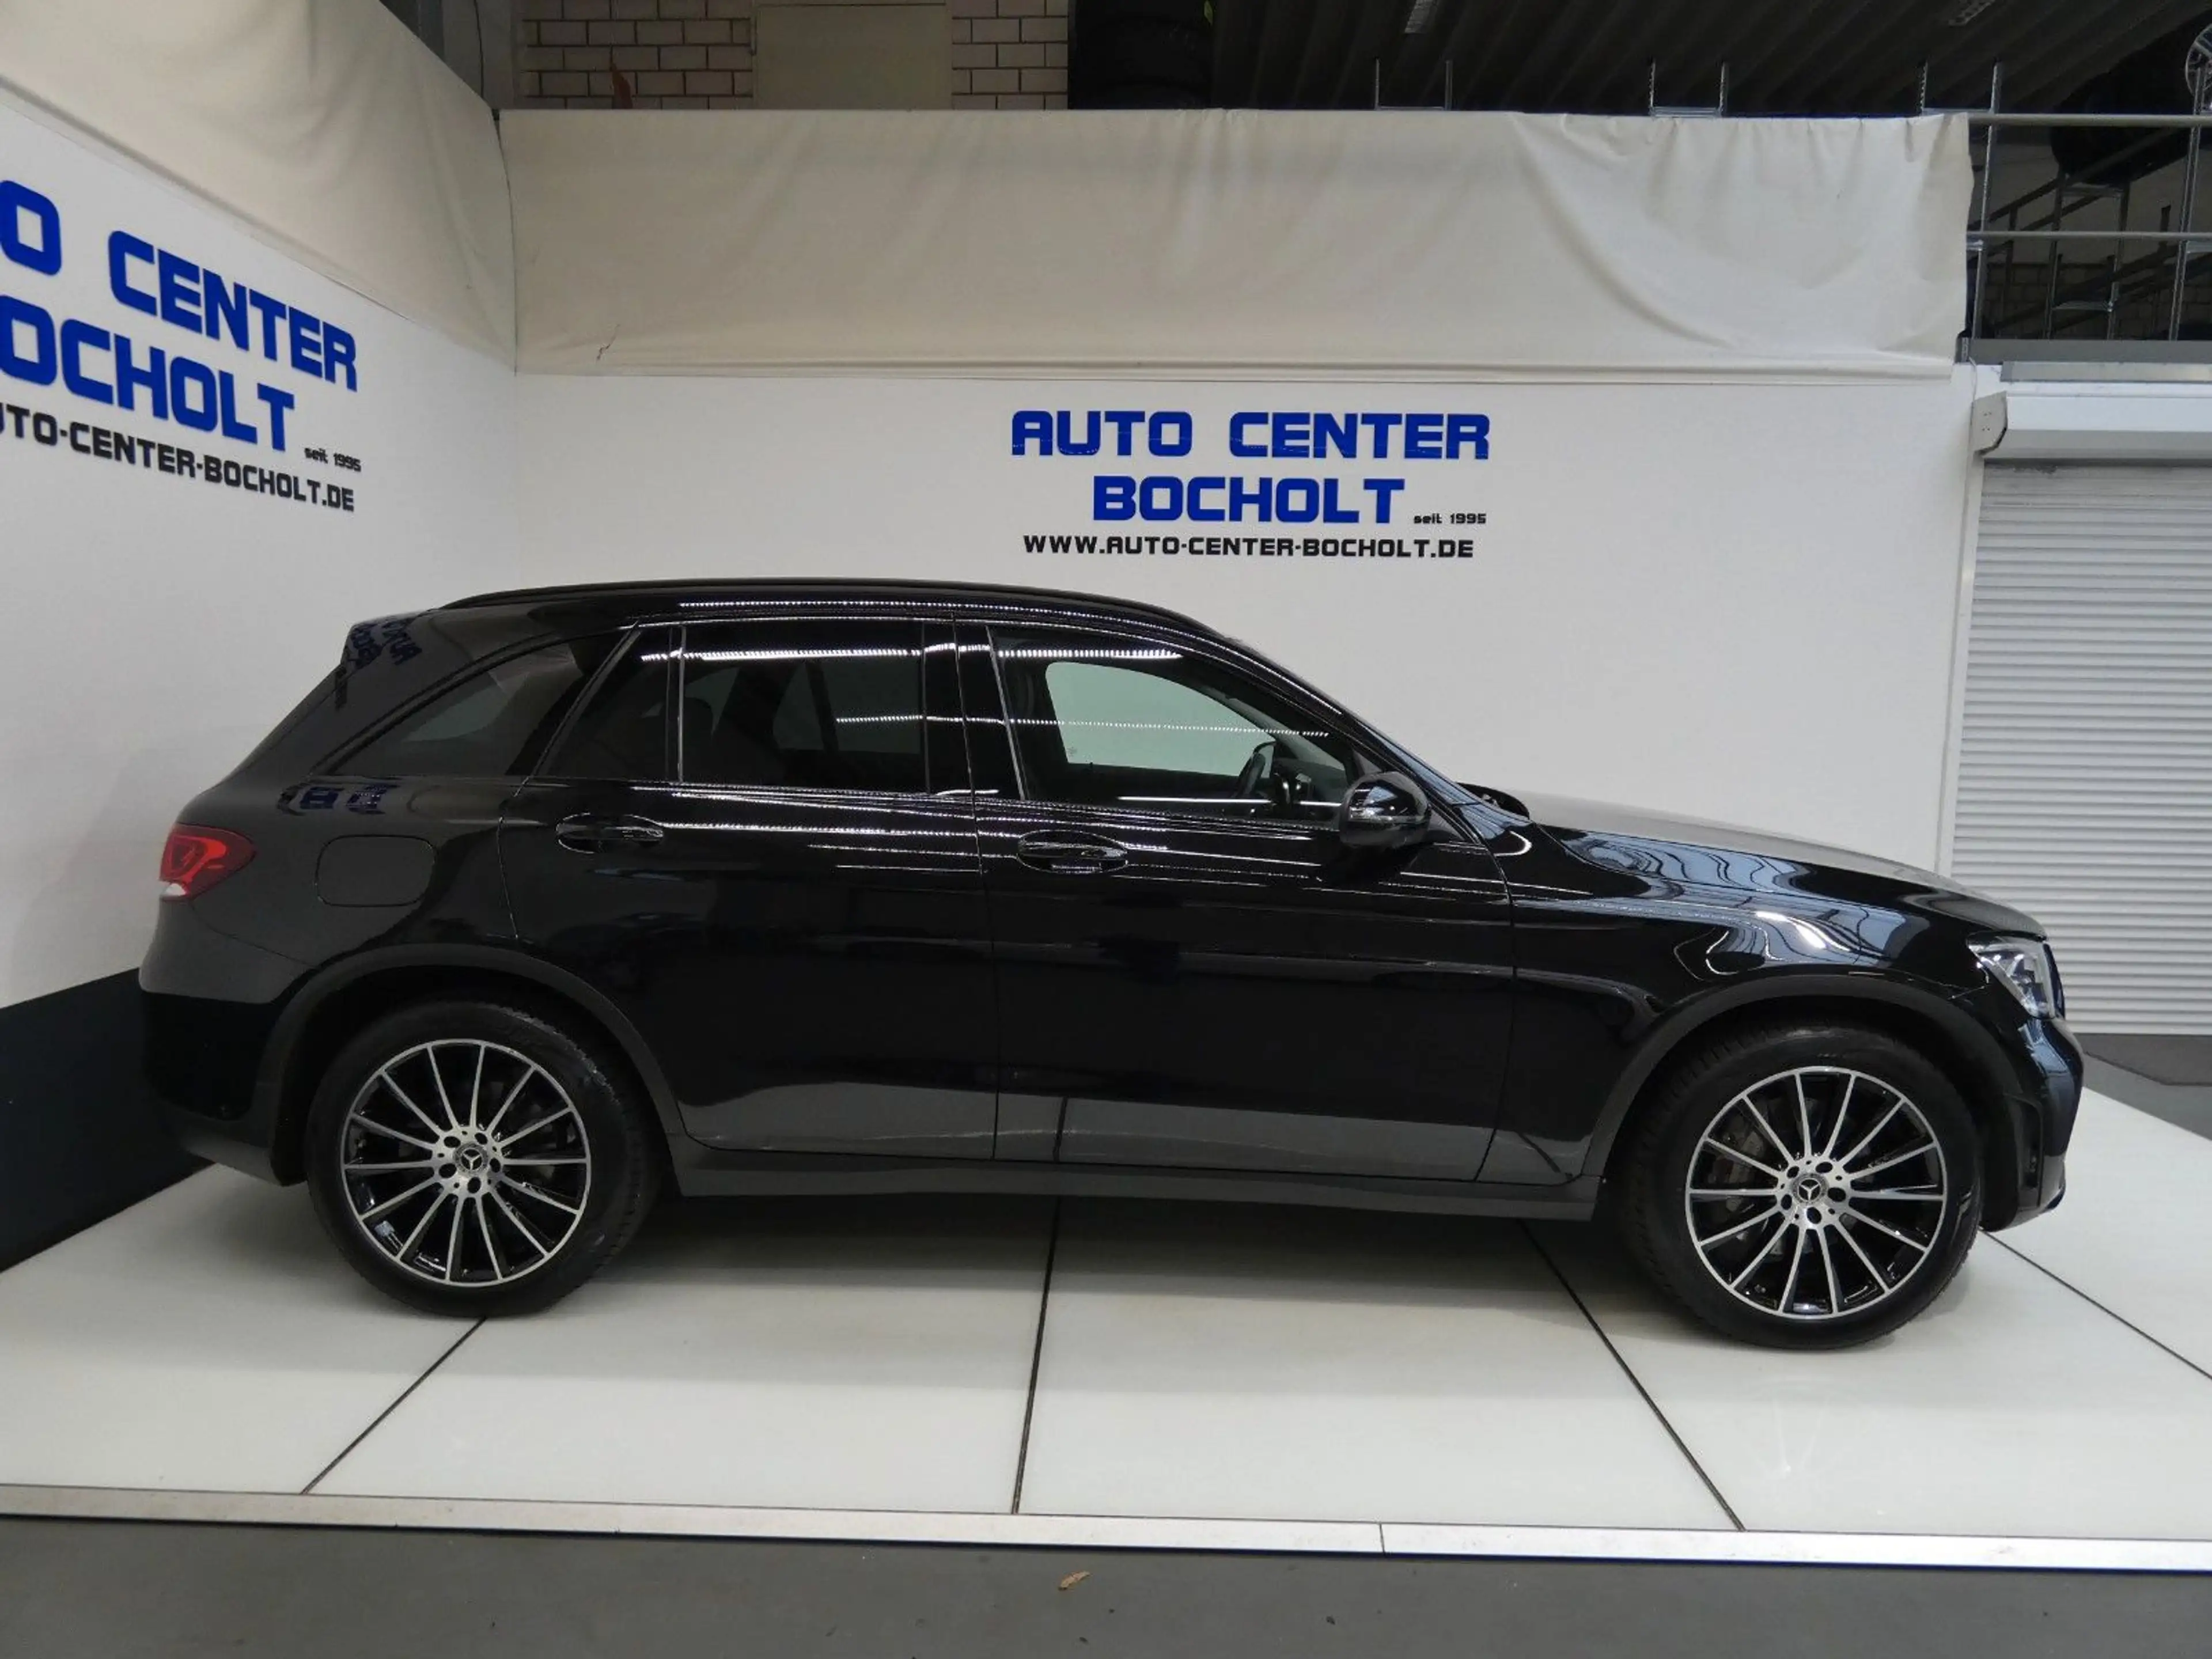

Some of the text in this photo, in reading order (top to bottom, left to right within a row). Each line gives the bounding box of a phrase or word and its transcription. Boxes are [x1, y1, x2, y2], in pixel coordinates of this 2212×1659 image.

[108, 231, 357, 392] CENTER
[0, 402, 354, 512] TO-CENTER-BOCHOLT.DE
[304, 448, 362, 472] seit 1995
[1012, 410, 1490, 460] AUTO CENTER
[1093, 475, 1406, 525] BOCHOLT
[1414, 513, 1487, 524] seit 1995
[1023, 535, 1474, 558] WWW.AUTO-CENTER-BOCHOLT.DE
